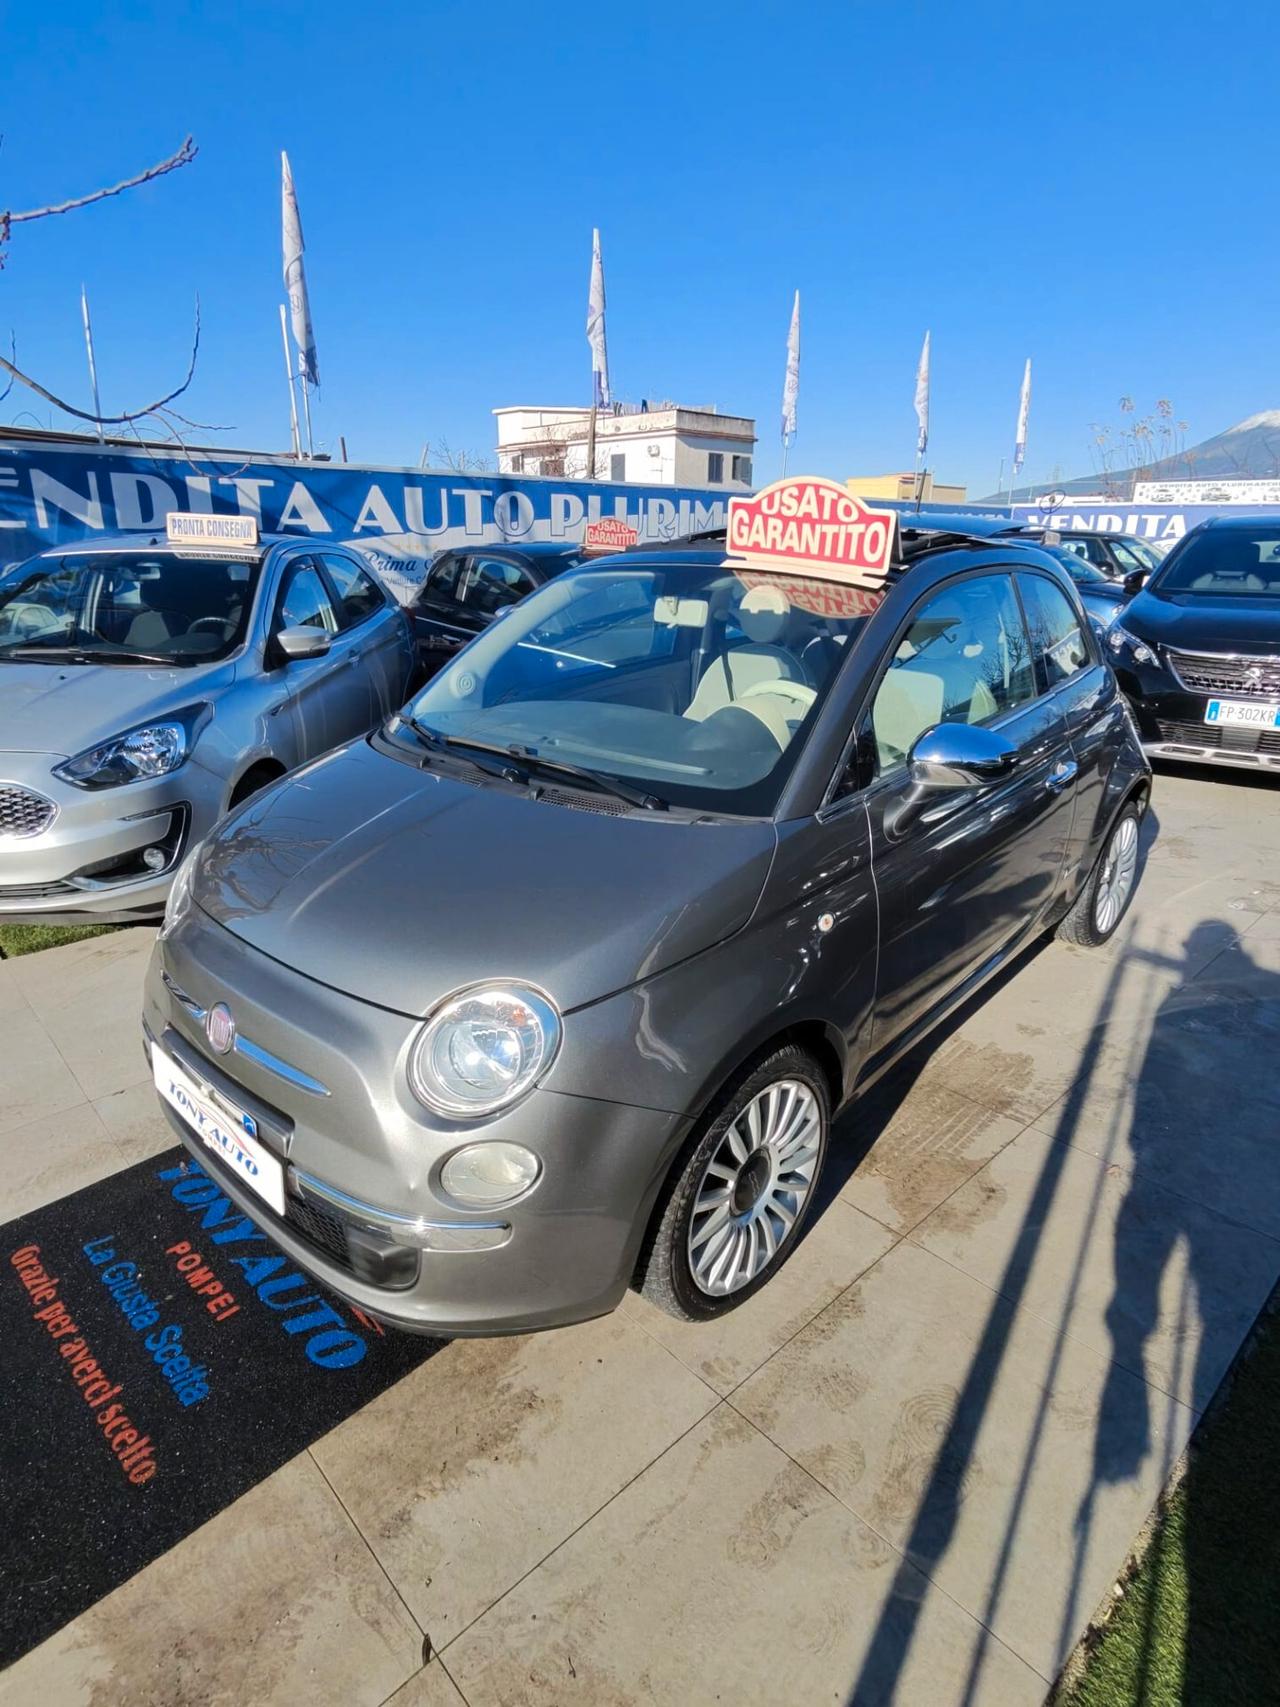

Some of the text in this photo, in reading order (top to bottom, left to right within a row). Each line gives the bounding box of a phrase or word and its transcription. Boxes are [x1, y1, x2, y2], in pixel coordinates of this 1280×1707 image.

[353, 483, 534, 537] AUTO
[597, 519, 630, 534] USATO
[761, 485, 859, 523] USATO
[1028, 514, 1187, 539] VENDITA
[172, 518, 252, 539] PRONTA CONSEGNA
[587, 527, 637, 546] GARANTITO
[731, 508, 887, 564] GARANTITO
[364, 550, 417, 571] Prima
[1219, 705, 1235, 719] FP
[169, 1079, 207, 1124] TONY
[209, 1126, 260, 1176] AUTO
[157, 1158, 368, 1370] TONY AUTO
[166, 1240, 242, 1322] POMPEI
[82, 1234, 210, 1408] La Giusta Scelta
[10, 1243, 159, 1486] Grazie per averci scelto
